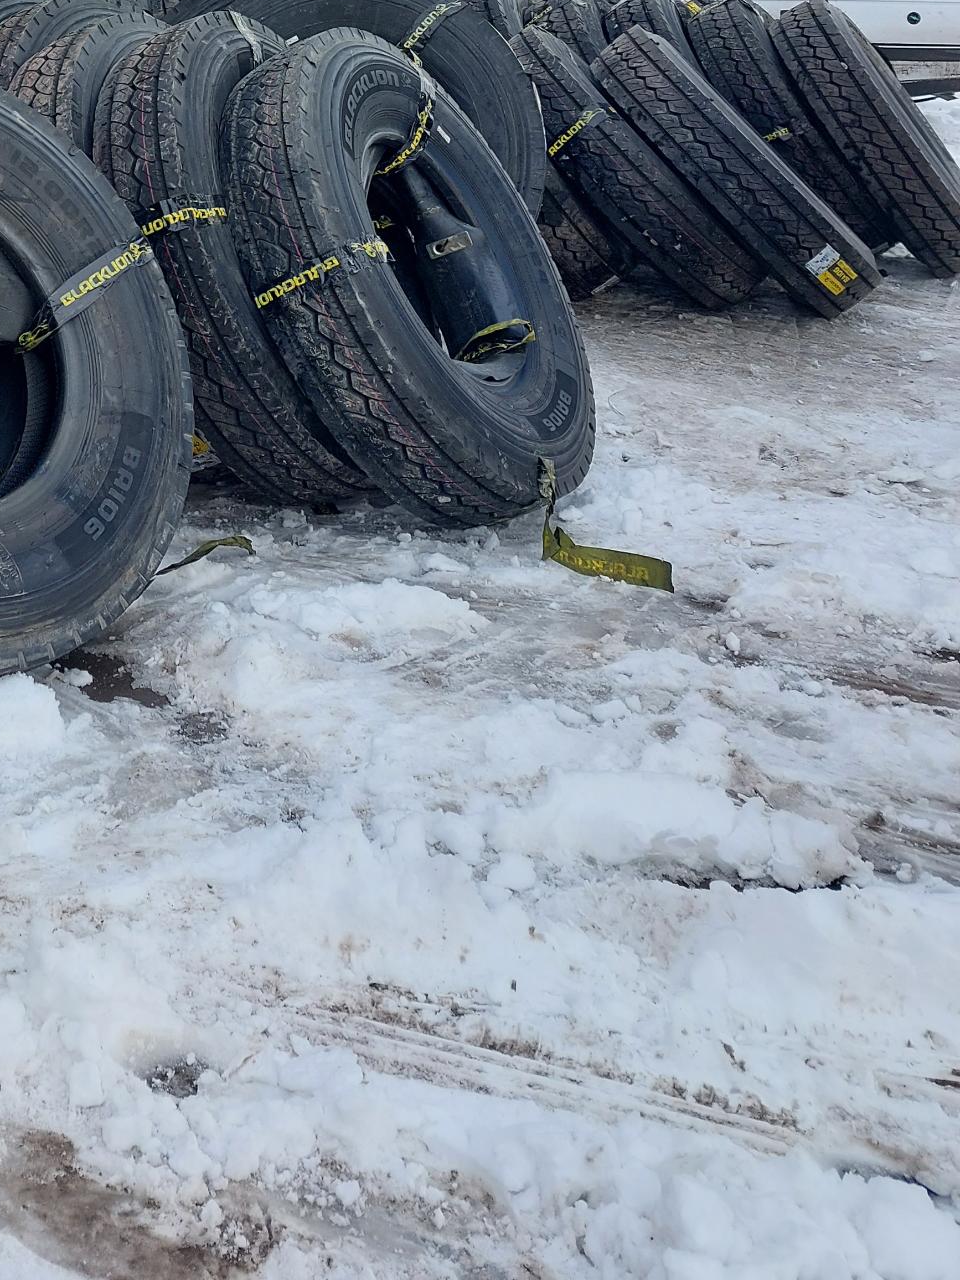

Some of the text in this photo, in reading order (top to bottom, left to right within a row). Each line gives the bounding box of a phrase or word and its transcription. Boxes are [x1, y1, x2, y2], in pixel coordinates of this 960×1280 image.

[342, 70, 401, 148] BLACKLION
[548, 118, 586, 158] ACKLION
[60, 251, 134, 307] BLACKLION
